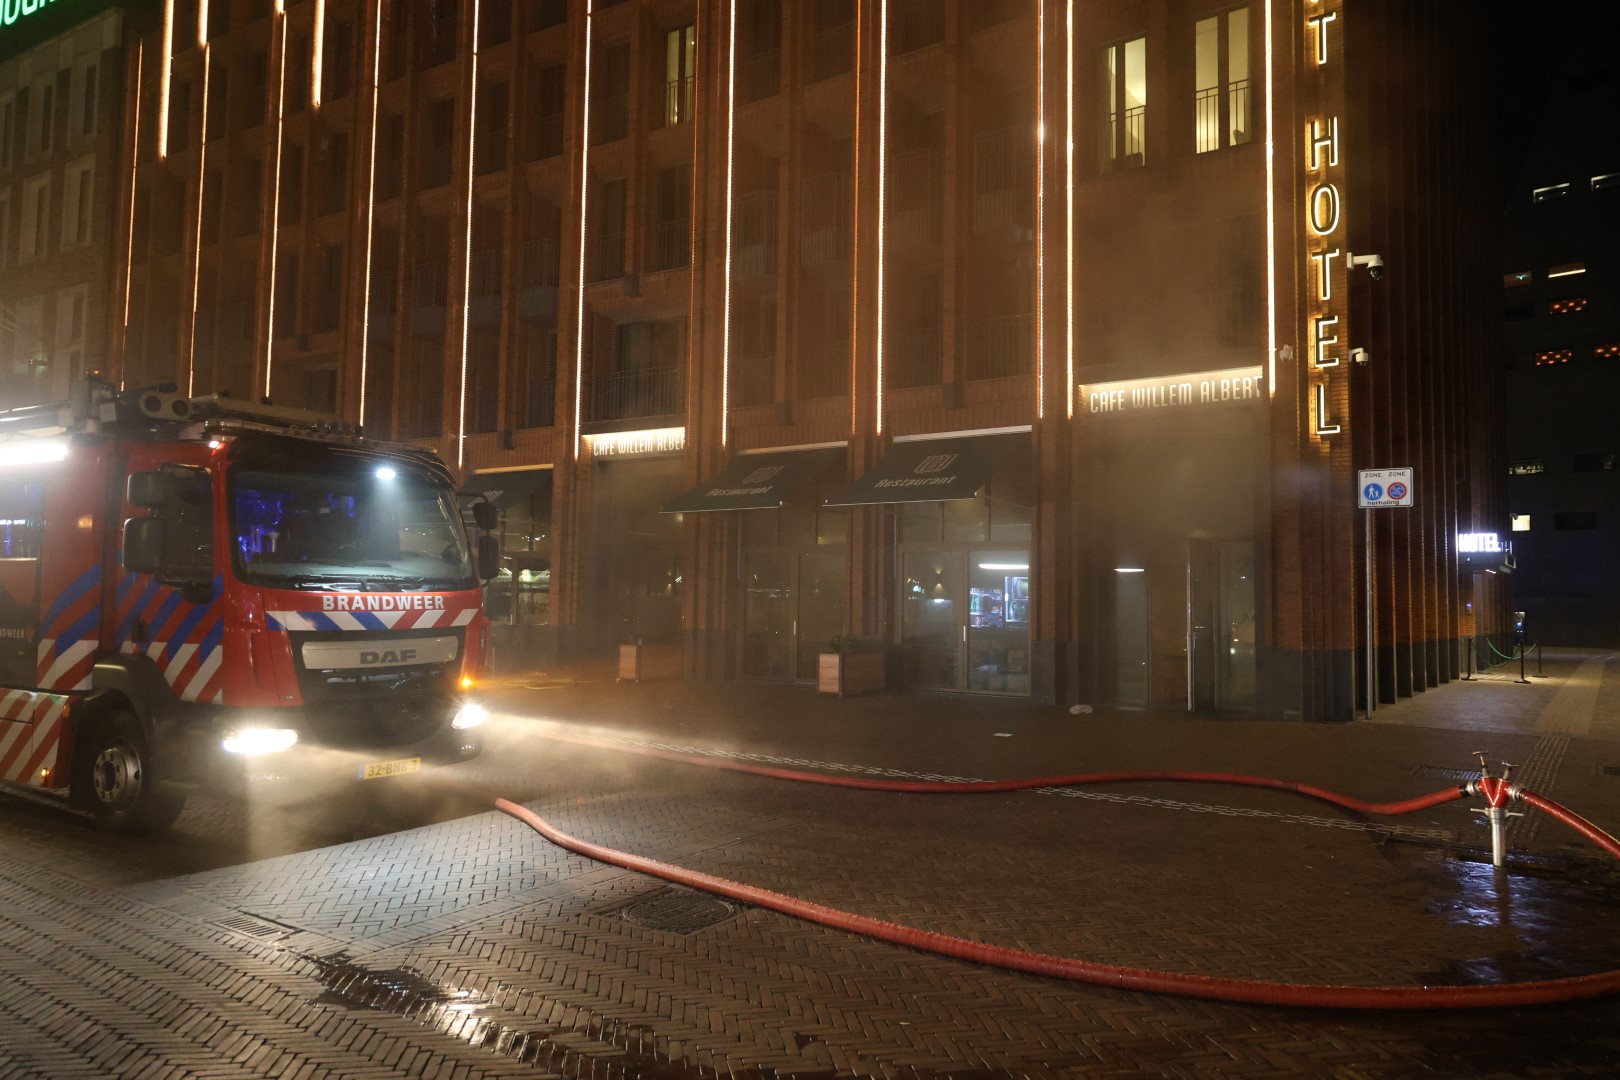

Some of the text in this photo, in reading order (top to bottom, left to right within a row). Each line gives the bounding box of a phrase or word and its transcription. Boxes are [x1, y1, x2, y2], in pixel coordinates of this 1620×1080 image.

[1310, 115, 1341, 435] HOTEL
[1090, 376, 1263, 413] CAFE WILLEM ALBERT
[593, 440, 615, 456] CAFE
[618, 437, 653, 454] WILLEM
[874, 475, 956, 488] Restaurant
[704, 485, 774, 497] Restaurant
[322, 595, 445, 611] BRANDWEER
[359, 649, 417, 665] DAF
